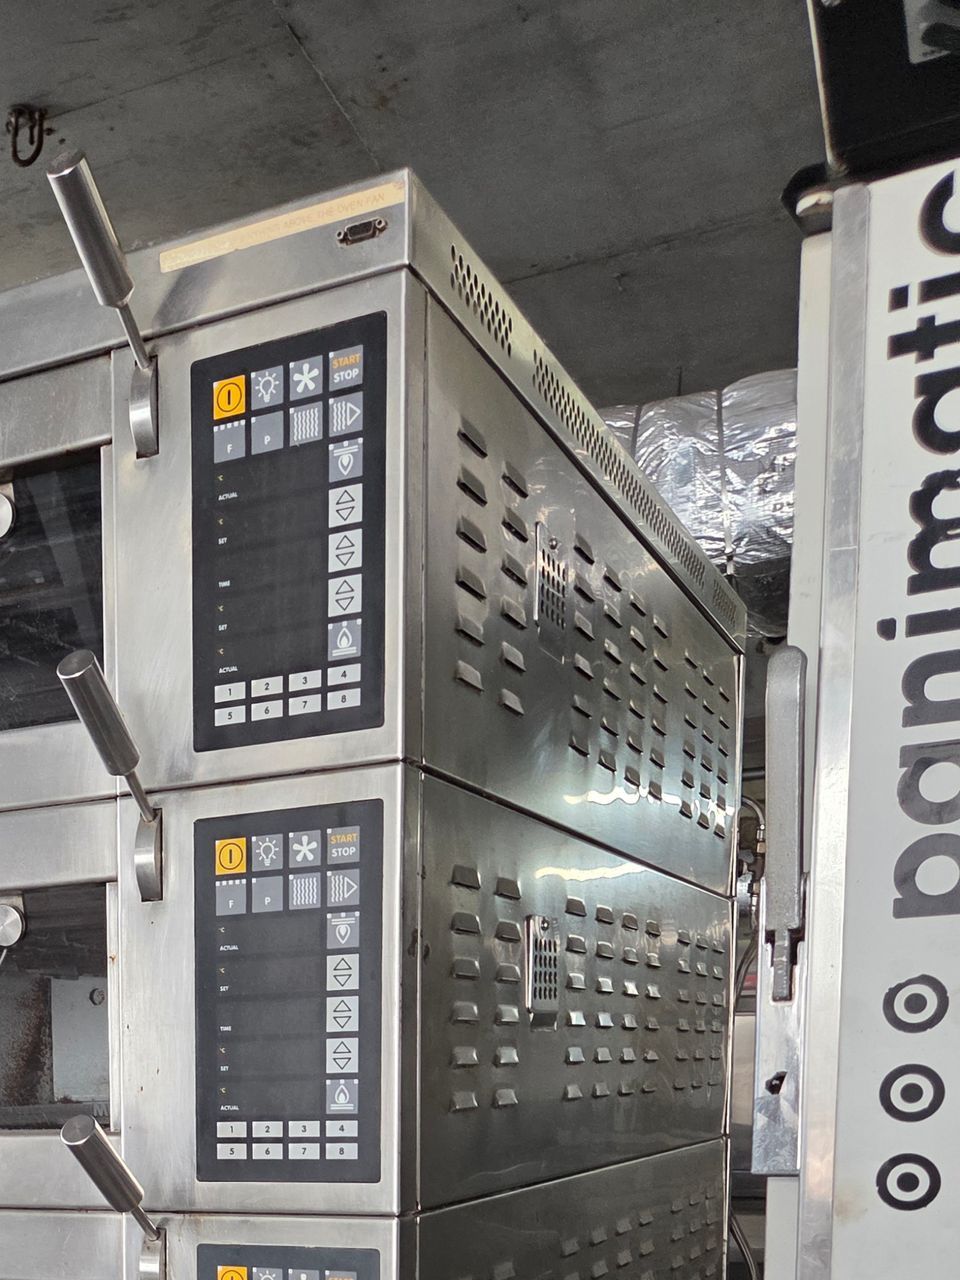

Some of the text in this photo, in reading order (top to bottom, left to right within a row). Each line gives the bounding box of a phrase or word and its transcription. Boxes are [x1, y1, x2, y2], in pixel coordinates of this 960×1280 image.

[332, 353, 360, 368] START
[334, 368, 359, 383] STOP
[264, 435, 271, 445] P
[227, 444, 232, 453] F
[218, 492, 238, 501] ACTUAL
[877, 171, 960, 919] panimatic
[228, 670, 347, 696] 1 2 3 4
[228, 695, 346, 720] 5 6 7 8
[331, 833, 357, 844] START
[332, 847, 356, 857] STOP
[229, 900, 233, 908] F
[265, 897, 271, 905] P
[265, 1125, 270, 1133] 2
[302, 1125, 307, 1133] 3
[302, 1147, 307, 1155] 7
[339, 1147, 344, 1155] 8
